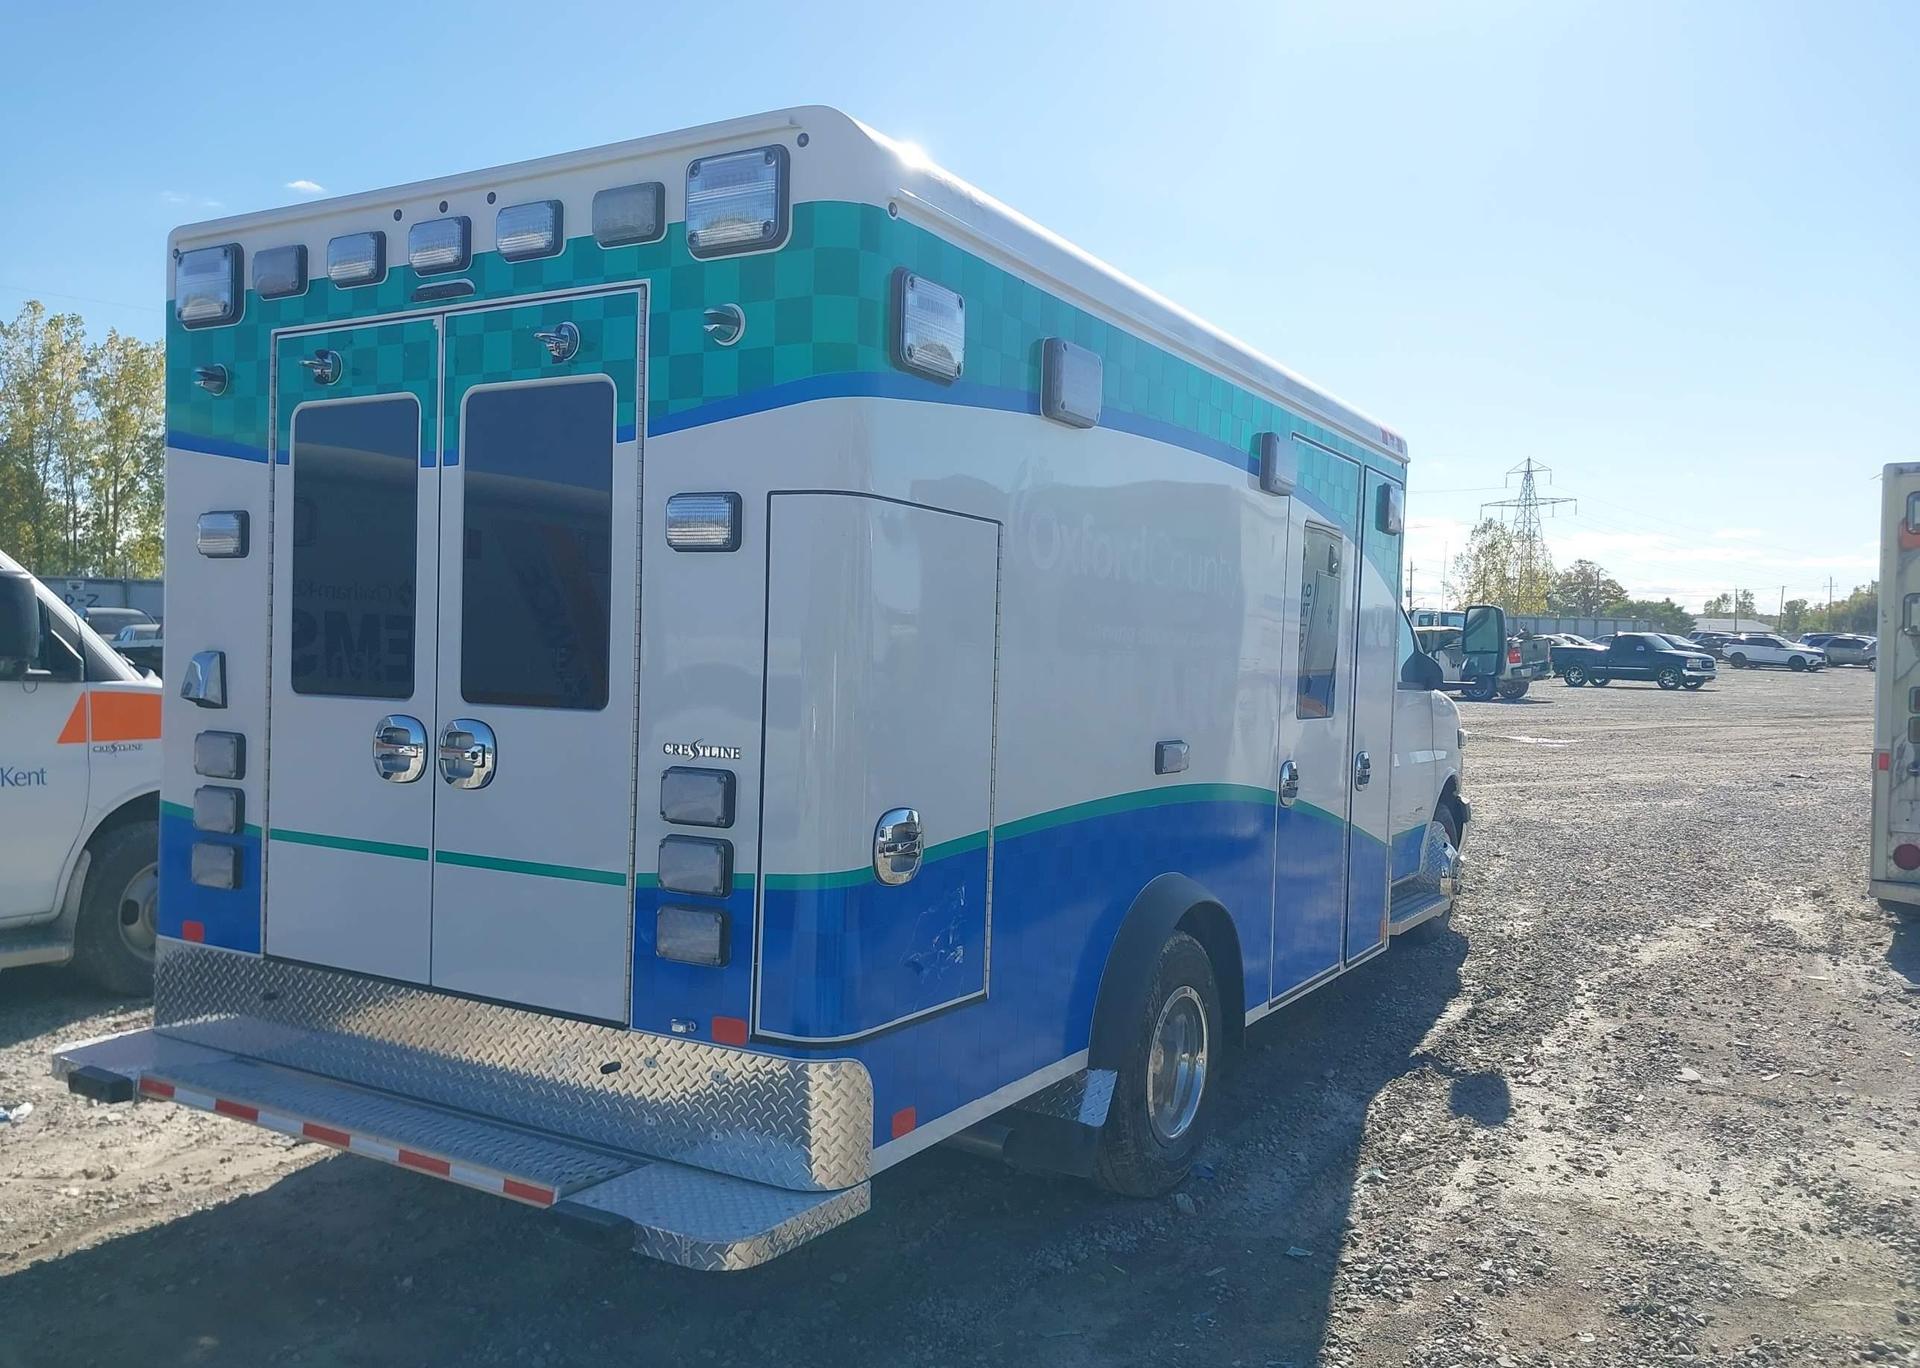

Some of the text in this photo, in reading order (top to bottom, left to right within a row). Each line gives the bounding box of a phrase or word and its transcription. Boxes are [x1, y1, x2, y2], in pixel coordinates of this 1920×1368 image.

[92, 742, 143, 755] CRESTLINE
[662, 738, 742, 761] CRESTLINE
[0, 766, 47, 787] Kent
